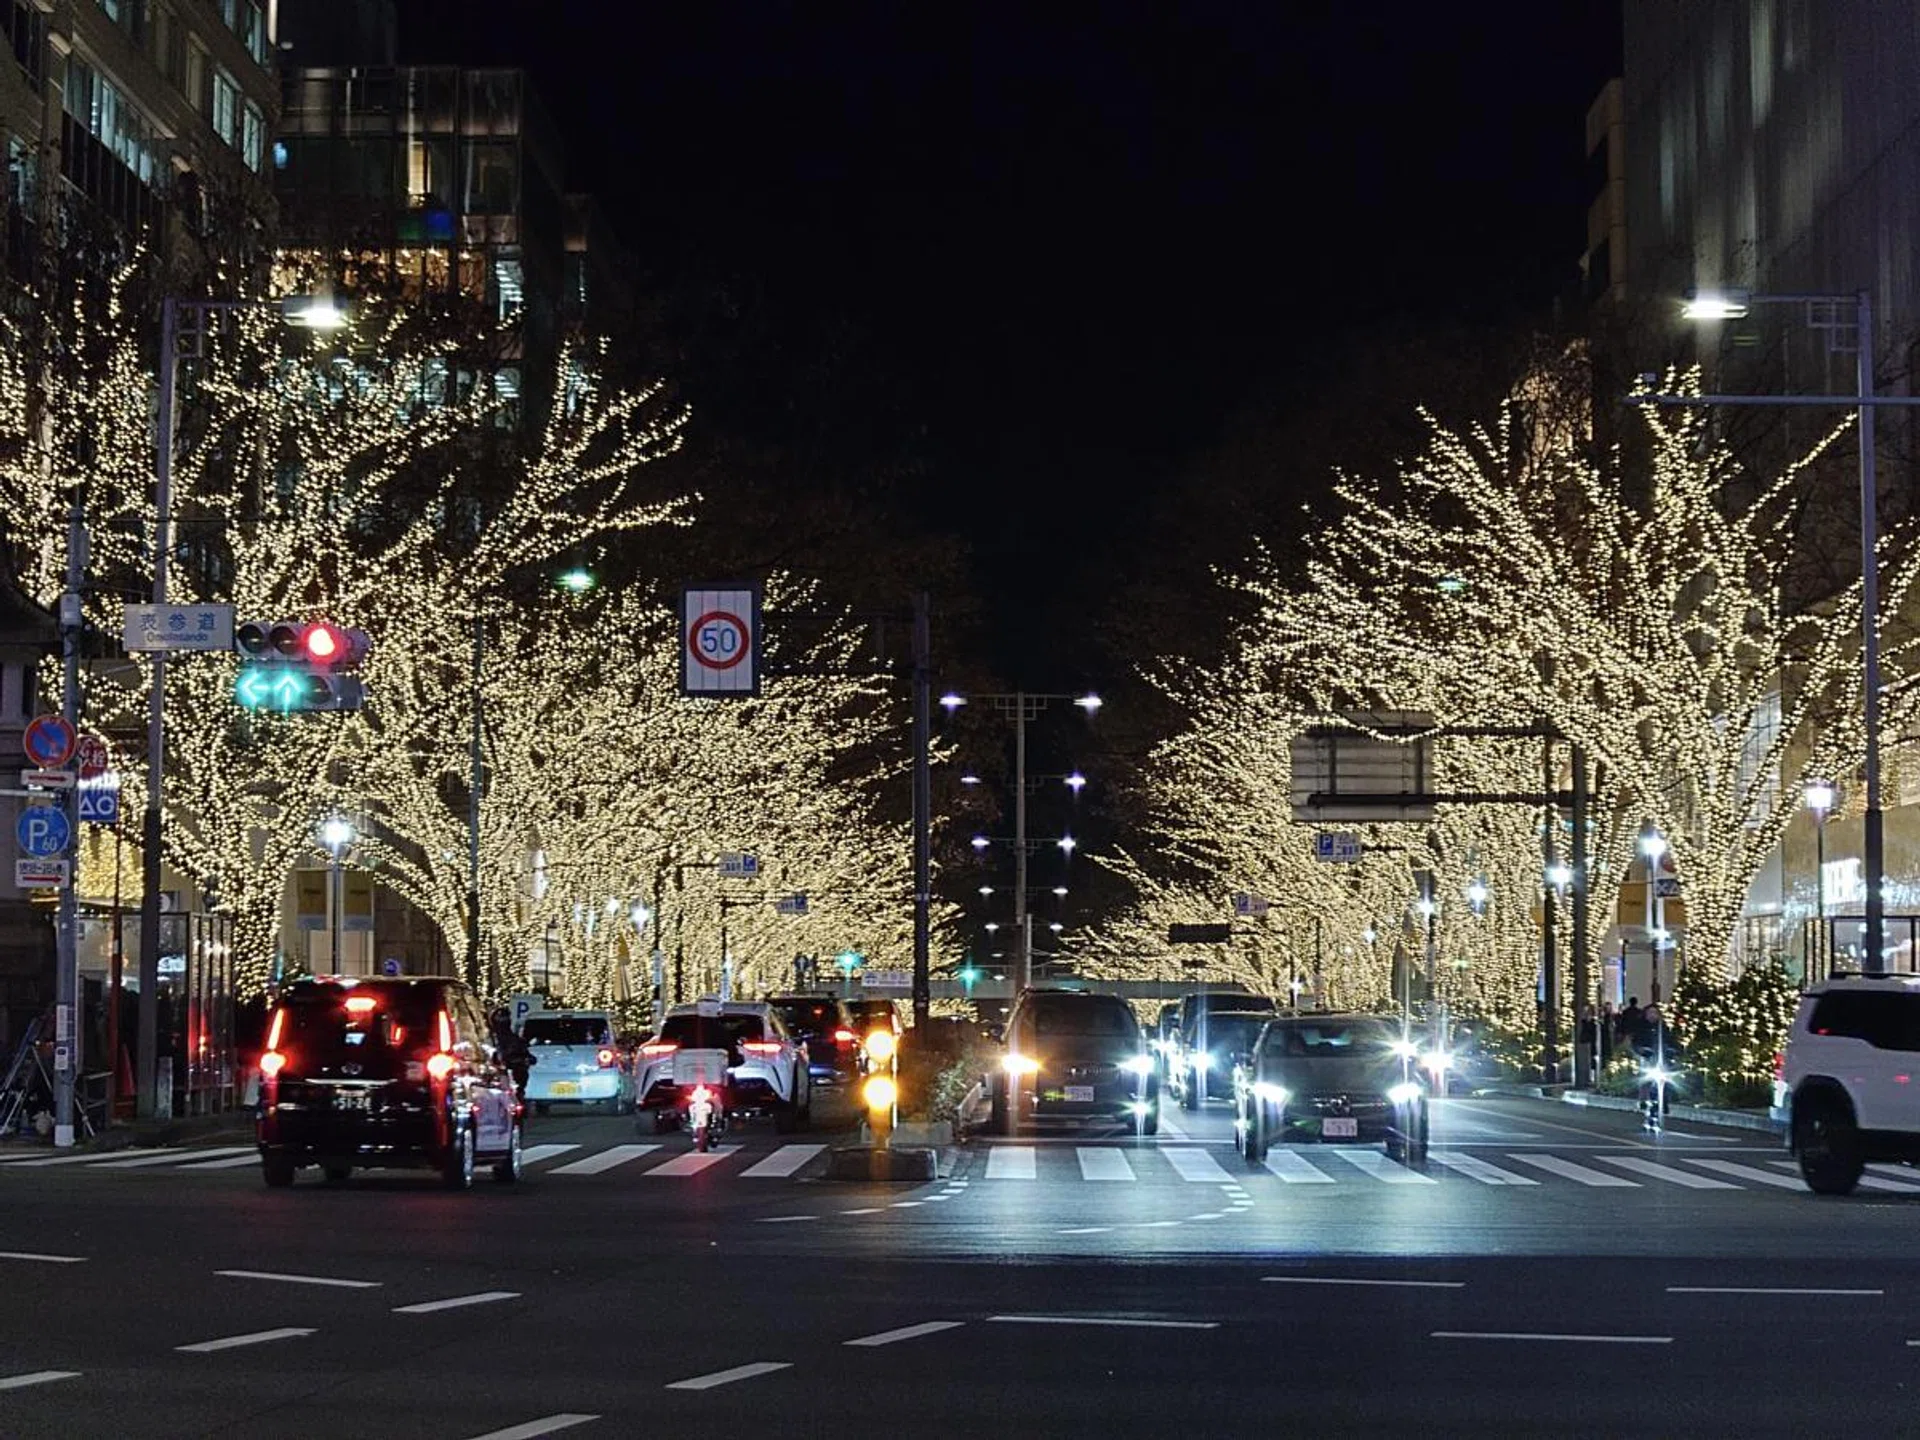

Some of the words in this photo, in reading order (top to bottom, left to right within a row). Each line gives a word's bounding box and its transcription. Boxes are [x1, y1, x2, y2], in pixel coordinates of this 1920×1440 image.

[139, 611, 217, 632] 表参道
[701, 627, 737, 653] 50
[29, 818, 49, 851] P
[41, 836, 58, 852] 60
[517, 1001, 530, 1019] P
